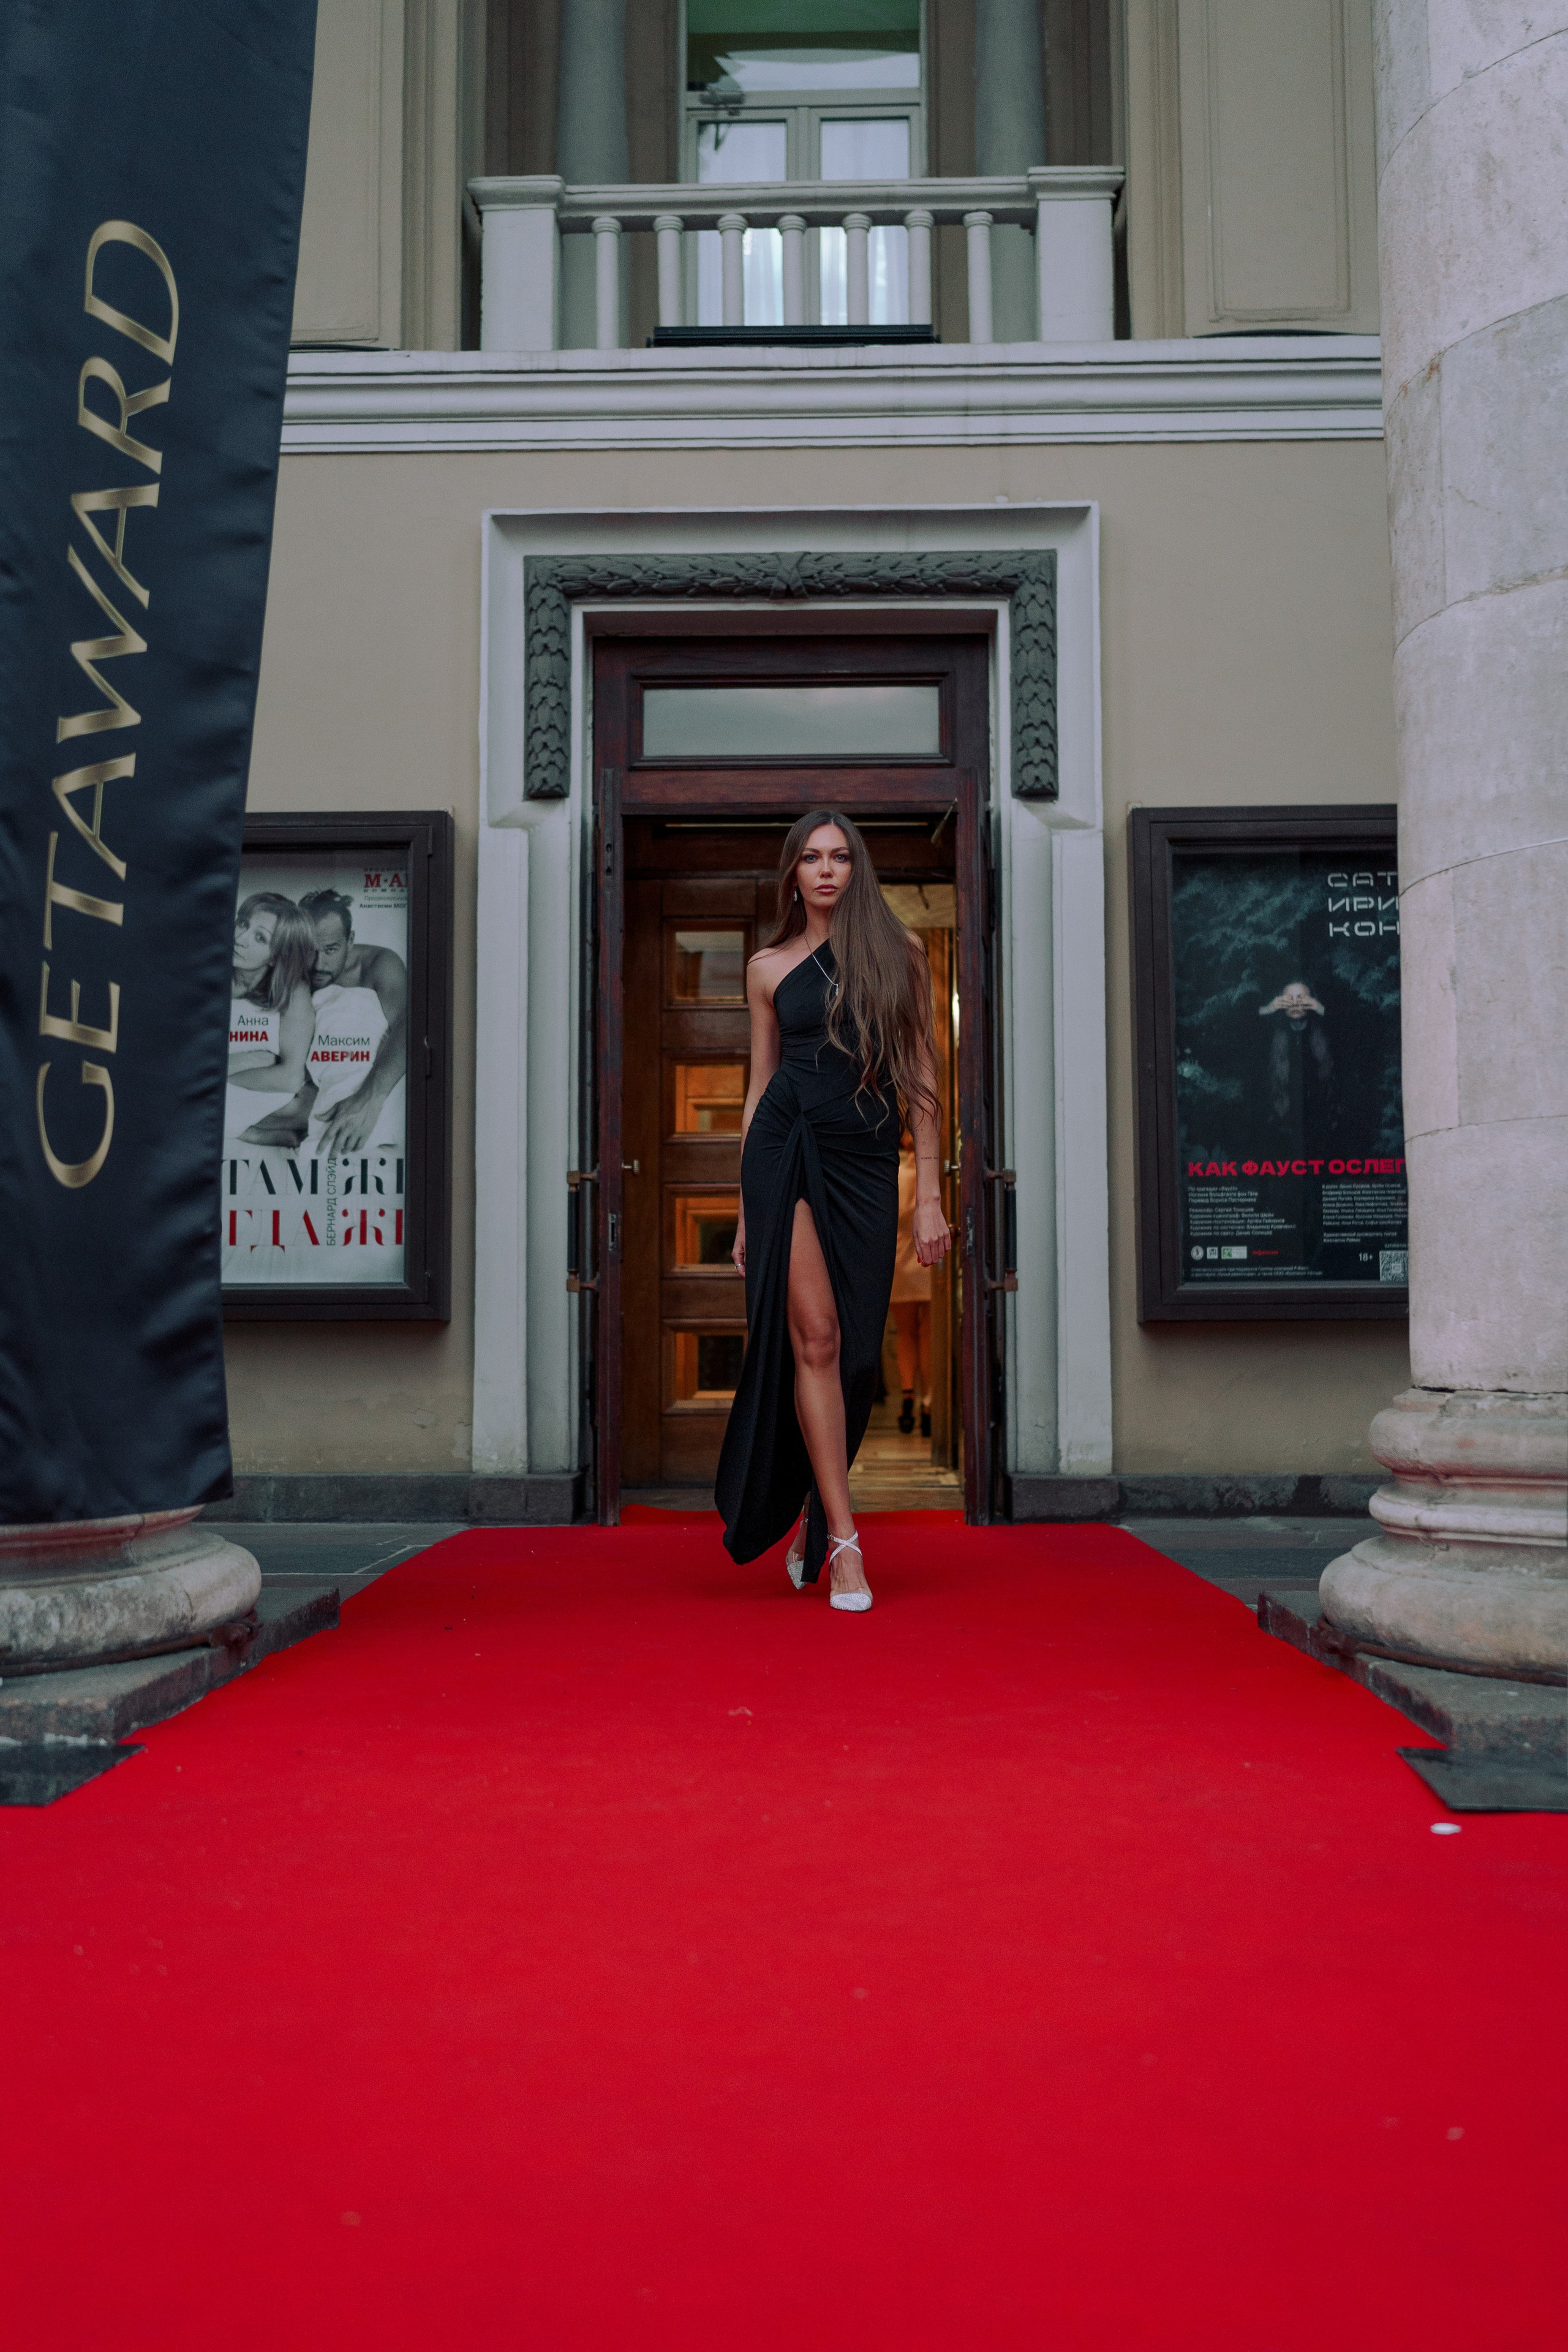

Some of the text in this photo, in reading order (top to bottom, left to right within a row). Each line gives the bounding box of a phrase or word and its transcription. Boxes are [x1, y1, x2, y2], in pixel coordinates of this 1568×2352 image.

[37, 219, 179, 1189] GETAWARD
[1327, 872, 1397, 888] САТ
[1329, 921, 1400, 937] КОН
[238, 1015, 269, 1026] Анна
[229, 1031, 269, 1042] НИНА
[318, 1035, 370, 1046] Максим
[311, 1050, 371, 1062] АВЕРИН
[1188, 1161, 1238, 1177] КАК
[1242, 1159, 1324, 1176] ФАУСТ
[222, 1158, 318, 1195] ТАМ
[326, 1157, 337, 1246] БЕРНАРД СЛЭЙД
[1359, 1252, 1373, 1262] 18+
